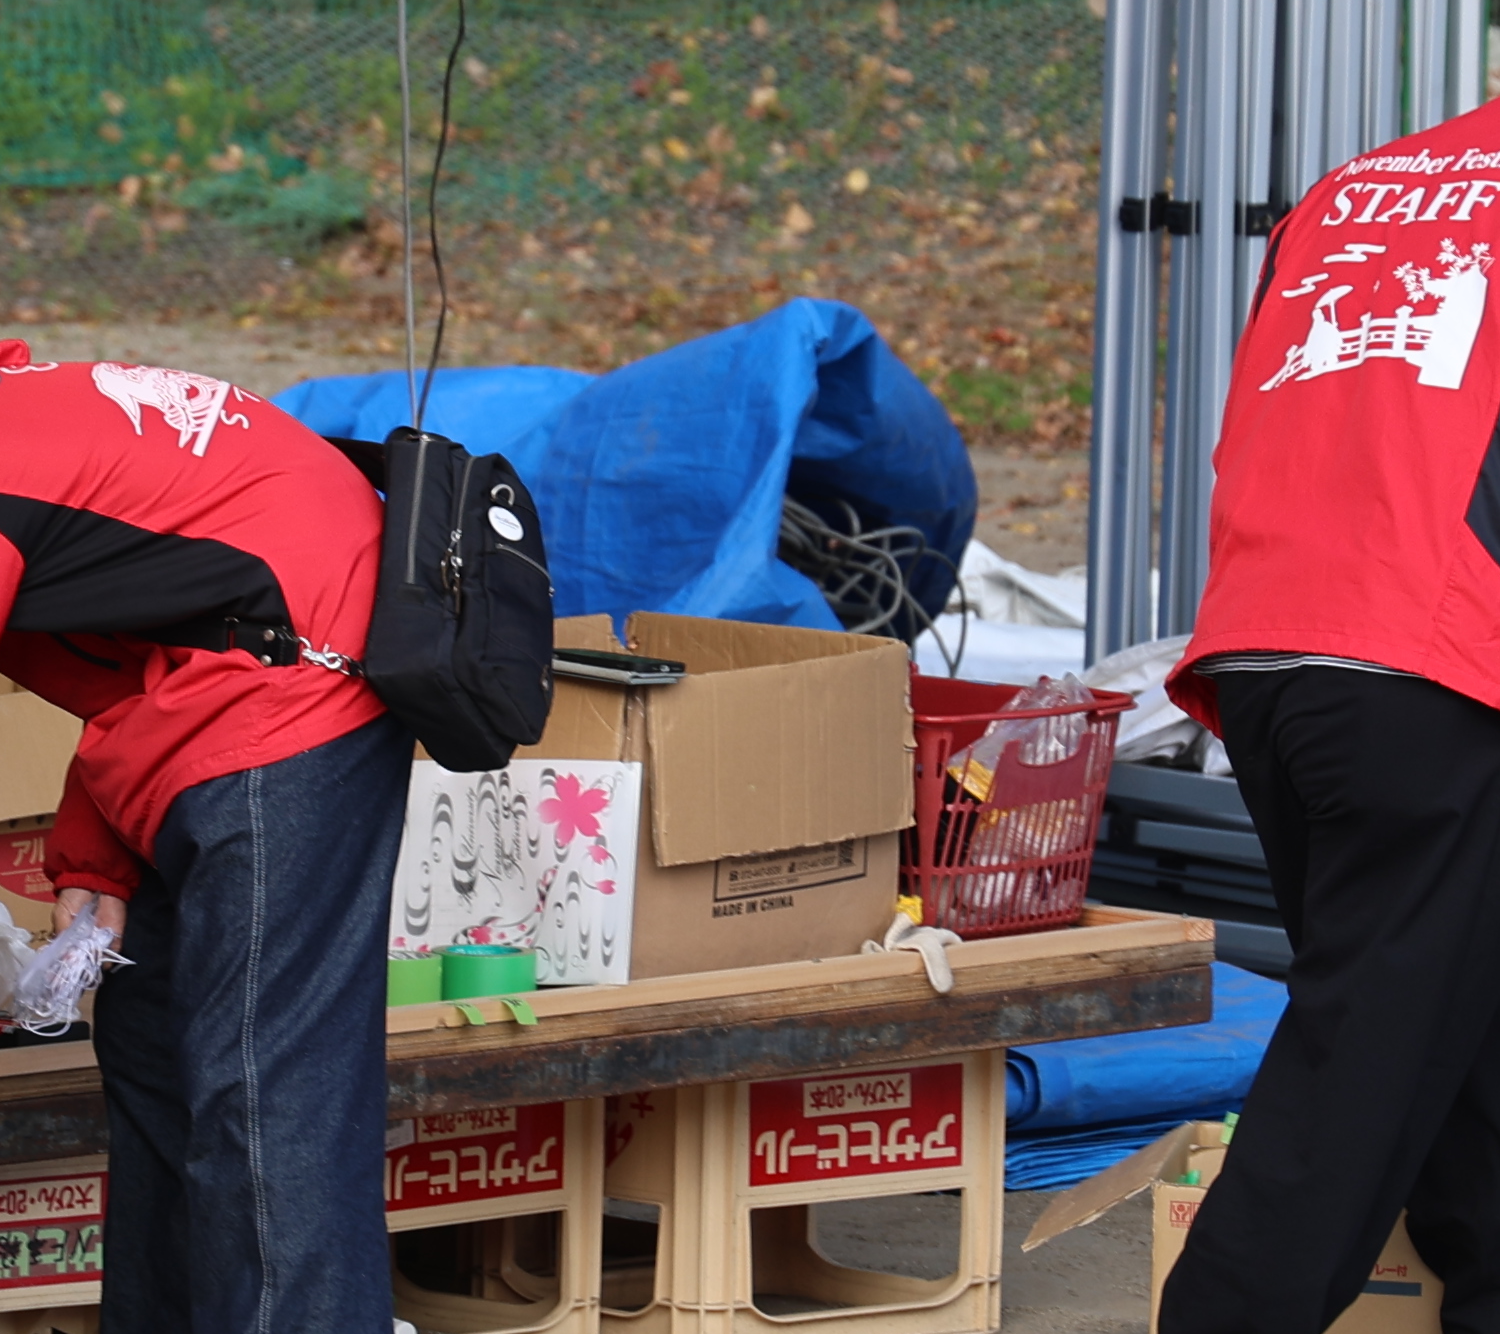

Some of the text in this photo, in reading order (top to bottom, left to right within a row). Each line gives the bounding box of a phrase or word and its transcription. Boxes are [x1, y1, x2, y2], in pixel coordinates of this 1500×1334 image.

[1334, 148, 1455, 183] November
[10, 836, 45, 867] アル
[712, 895, 794, 919] MADE IN CHINA
[754, 1113, 957, 1175] アサヒビール
